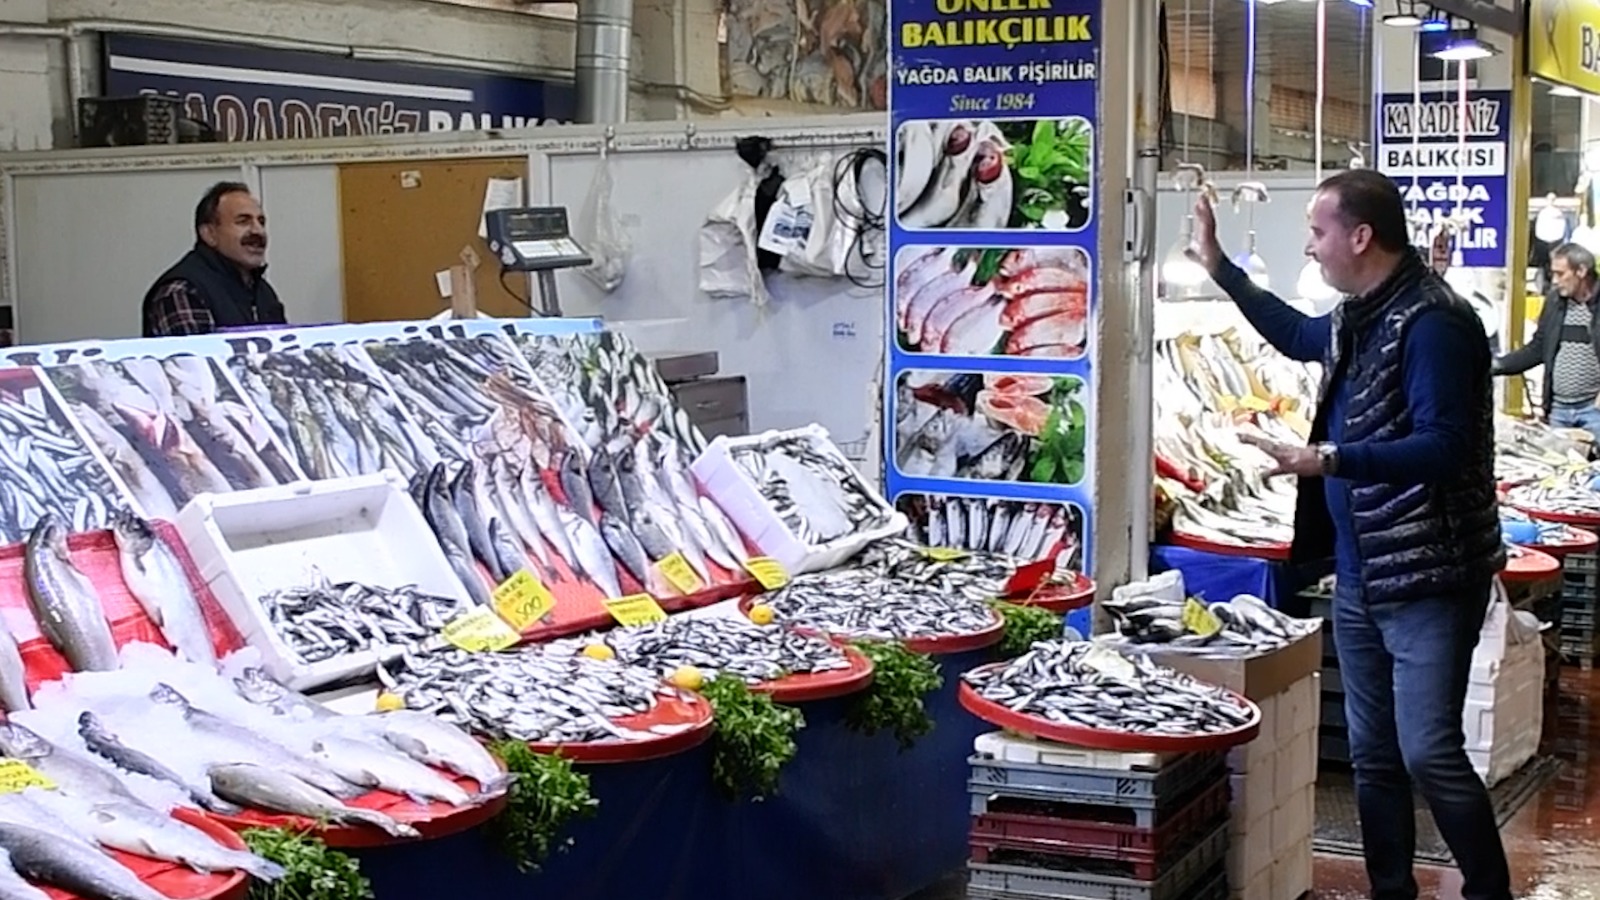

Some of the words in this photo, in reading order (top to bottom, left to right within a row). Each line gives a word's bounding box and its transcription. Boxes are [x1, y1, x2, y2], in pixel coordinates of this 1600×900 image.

[901, 15, 1093, 50] BALIKÇILIK
[897, 64, 960, 85] YAĞDA
[963, 65, 1014, 84] BALIK
[1018, 59, 1096, 85] PİŞİRİLİR
[949, 95, 991, 112] Since
[994, 93, 1036, 111] 1984
